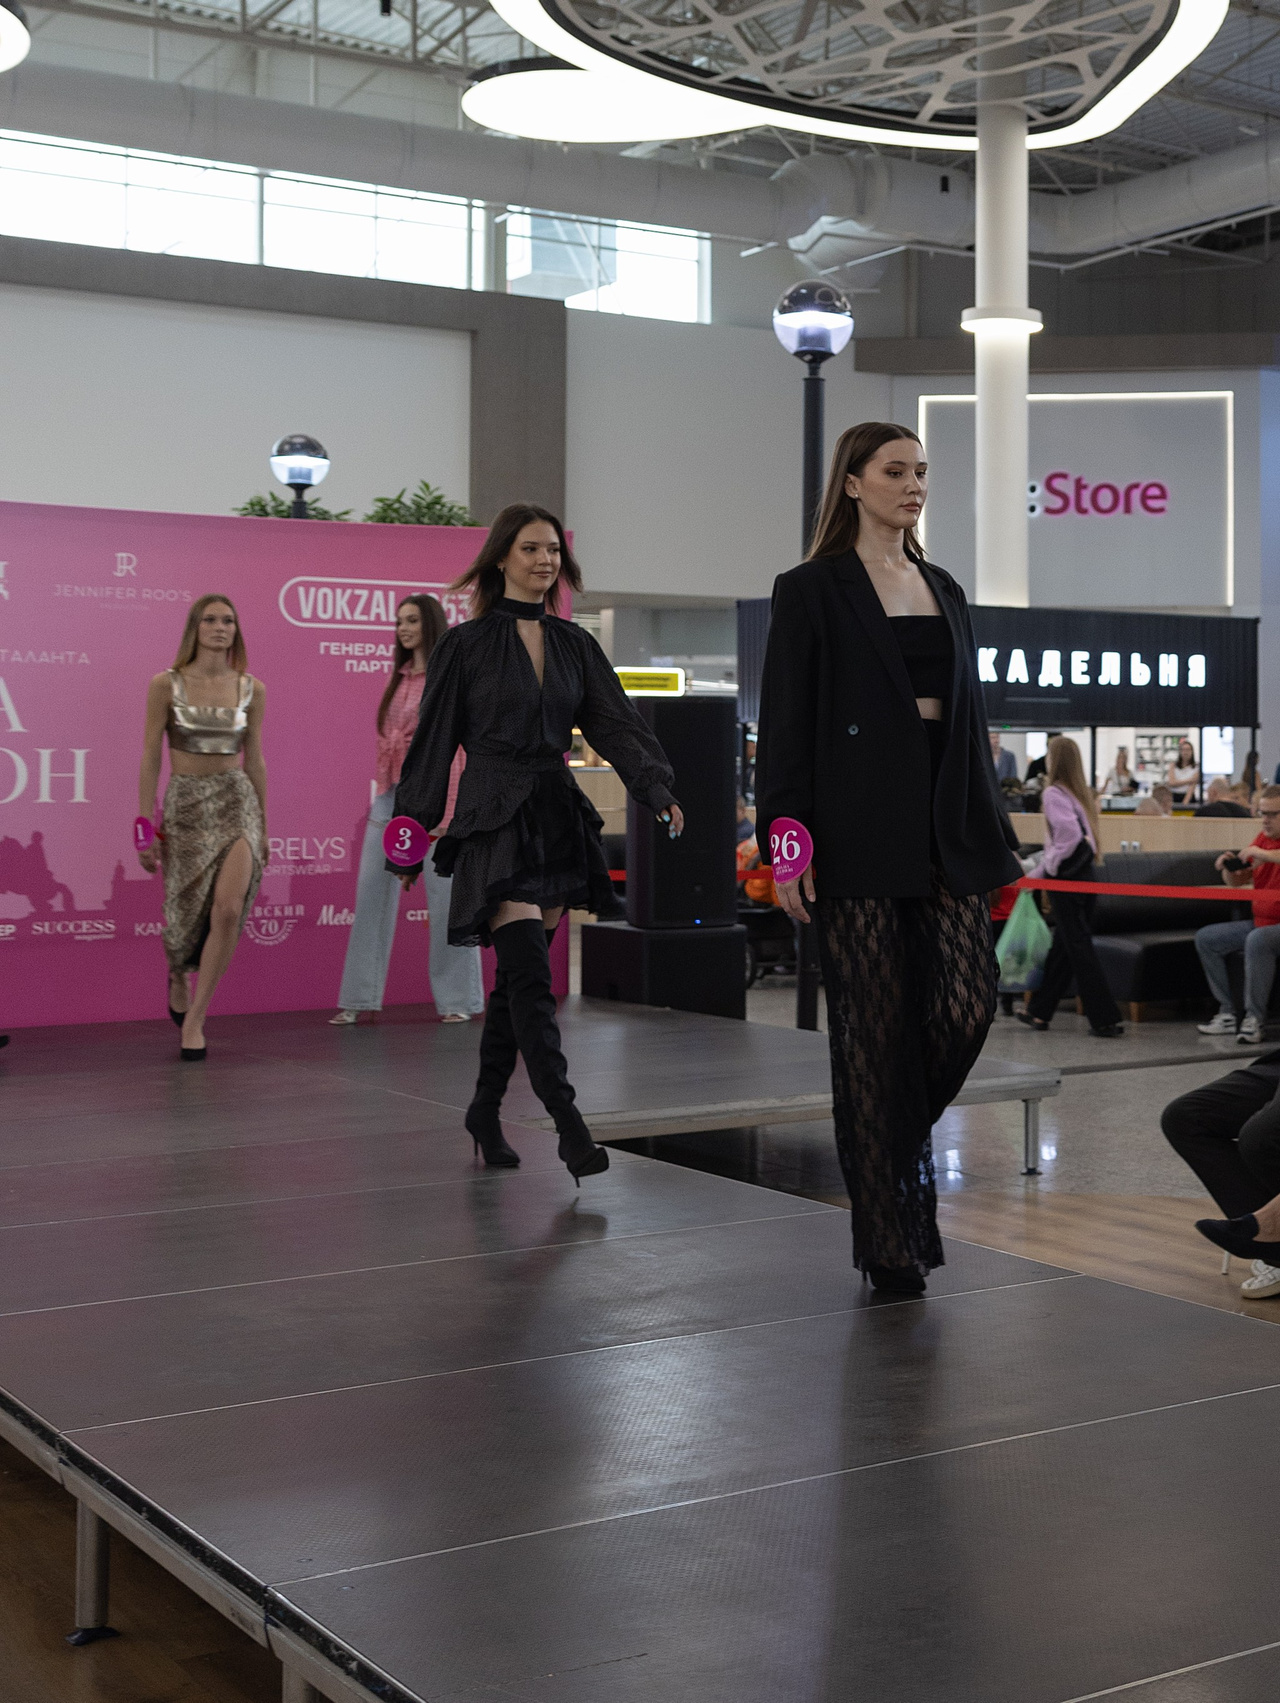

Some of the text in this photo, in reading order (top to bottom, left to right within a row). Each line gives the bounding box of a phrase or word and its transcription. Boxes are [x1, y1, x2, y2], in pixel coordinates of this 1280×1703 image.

[54, 584, 138, 599] JENNIFER
[298, 586, 398, 622] VOKZAL
[978, 647, 1206, 687] КАДЕЛЬНЯ
[136, 823, 145, 840] 1
[395, 827, 412, 850] 3
[770, 830, 801, 865] 26
[31, 919, 116, 935] SUCCESS
[260, 919, 279, 934] 70
